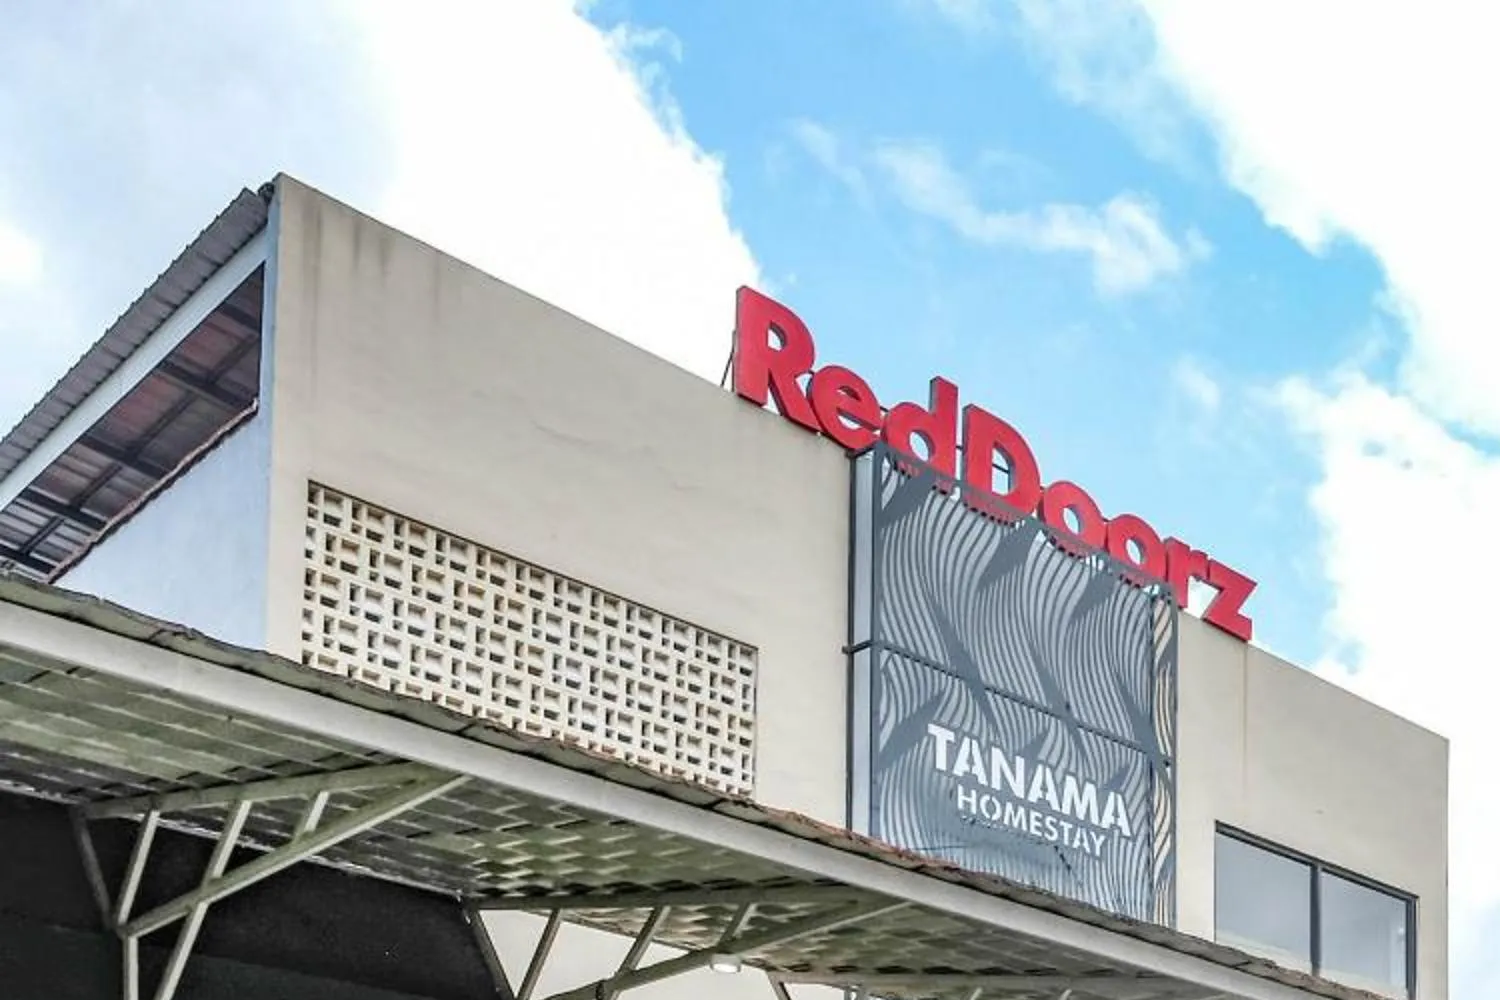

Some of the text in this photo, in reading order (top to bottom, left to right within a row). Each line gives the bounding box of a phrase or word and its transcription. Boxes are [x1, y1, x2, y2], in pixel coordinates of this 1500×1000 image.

[734, 285, 1258, 641] RedDoorz
[927, 722, 1132, 837] TANAMA
[957, 783, 1106, 858] HOMESTAY
